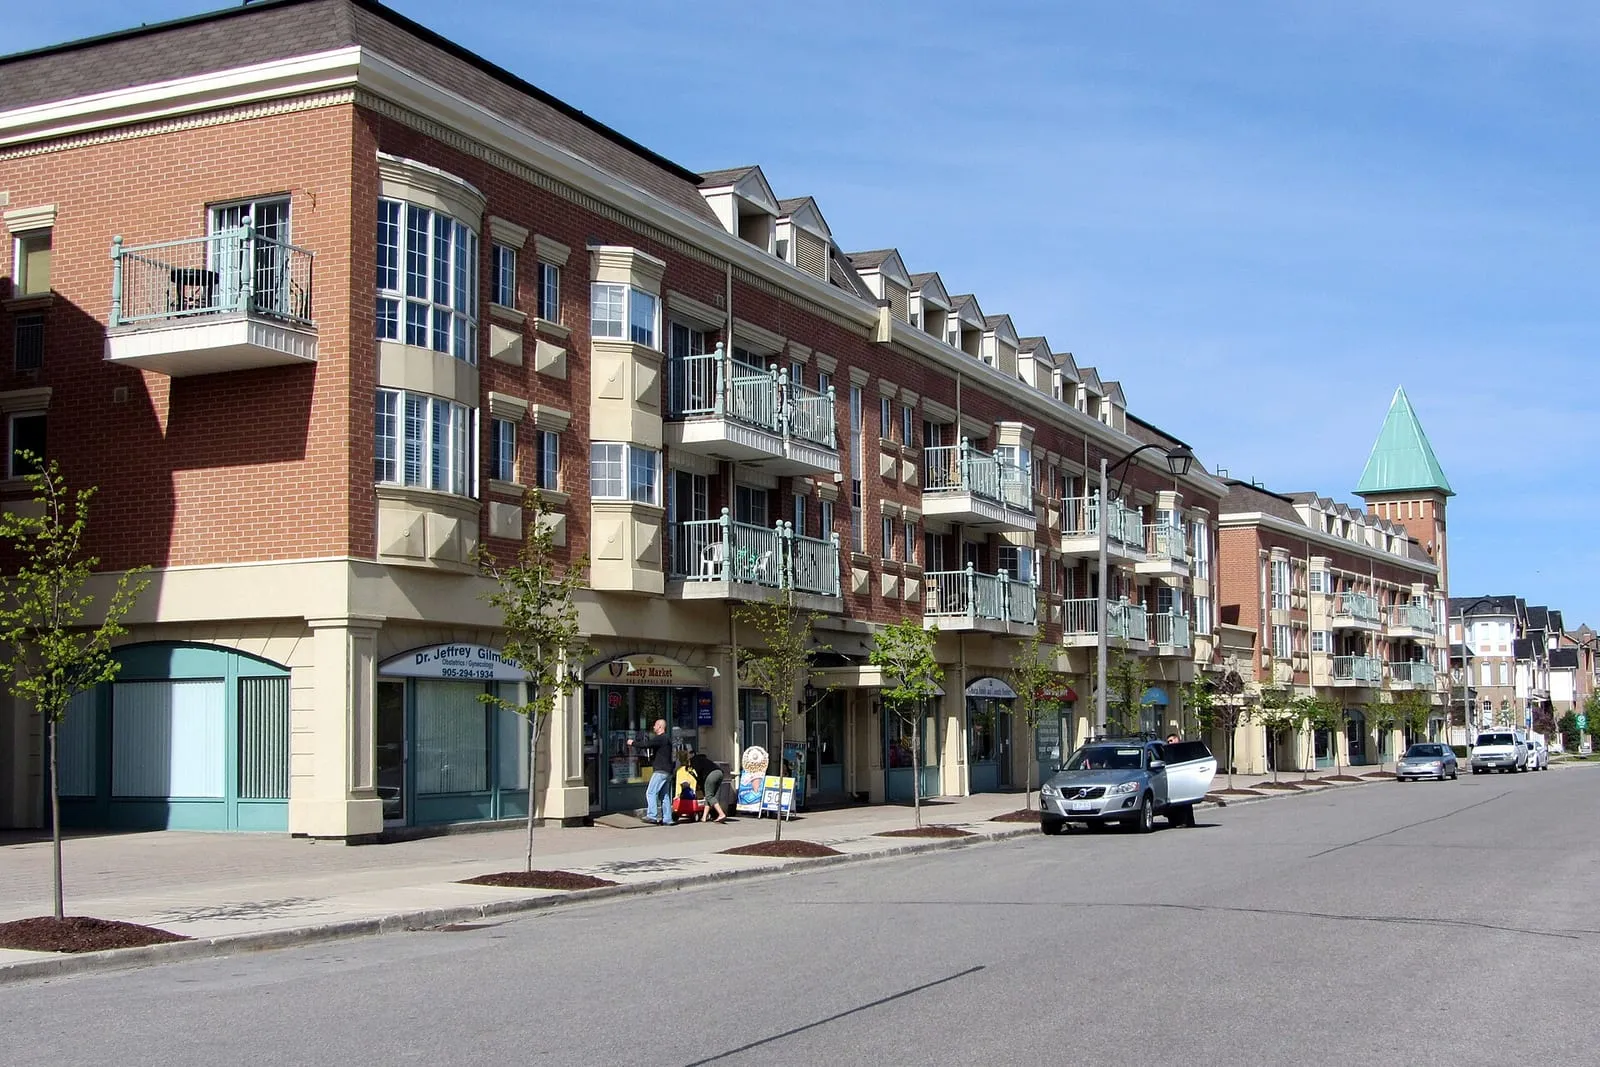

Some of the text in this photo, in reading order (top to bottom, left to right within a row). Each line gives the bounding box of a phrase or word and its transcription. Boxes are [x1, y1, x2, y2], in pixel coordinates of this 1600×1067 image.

[415, 653, 430, 665] Dr.
[433, 646, 471, 660] Jeffrey
[442, 659, 465, 667] Obstetrics
[441, 668, 494, 678] 905-294-1934
[648, 667, 673, 678] Market
